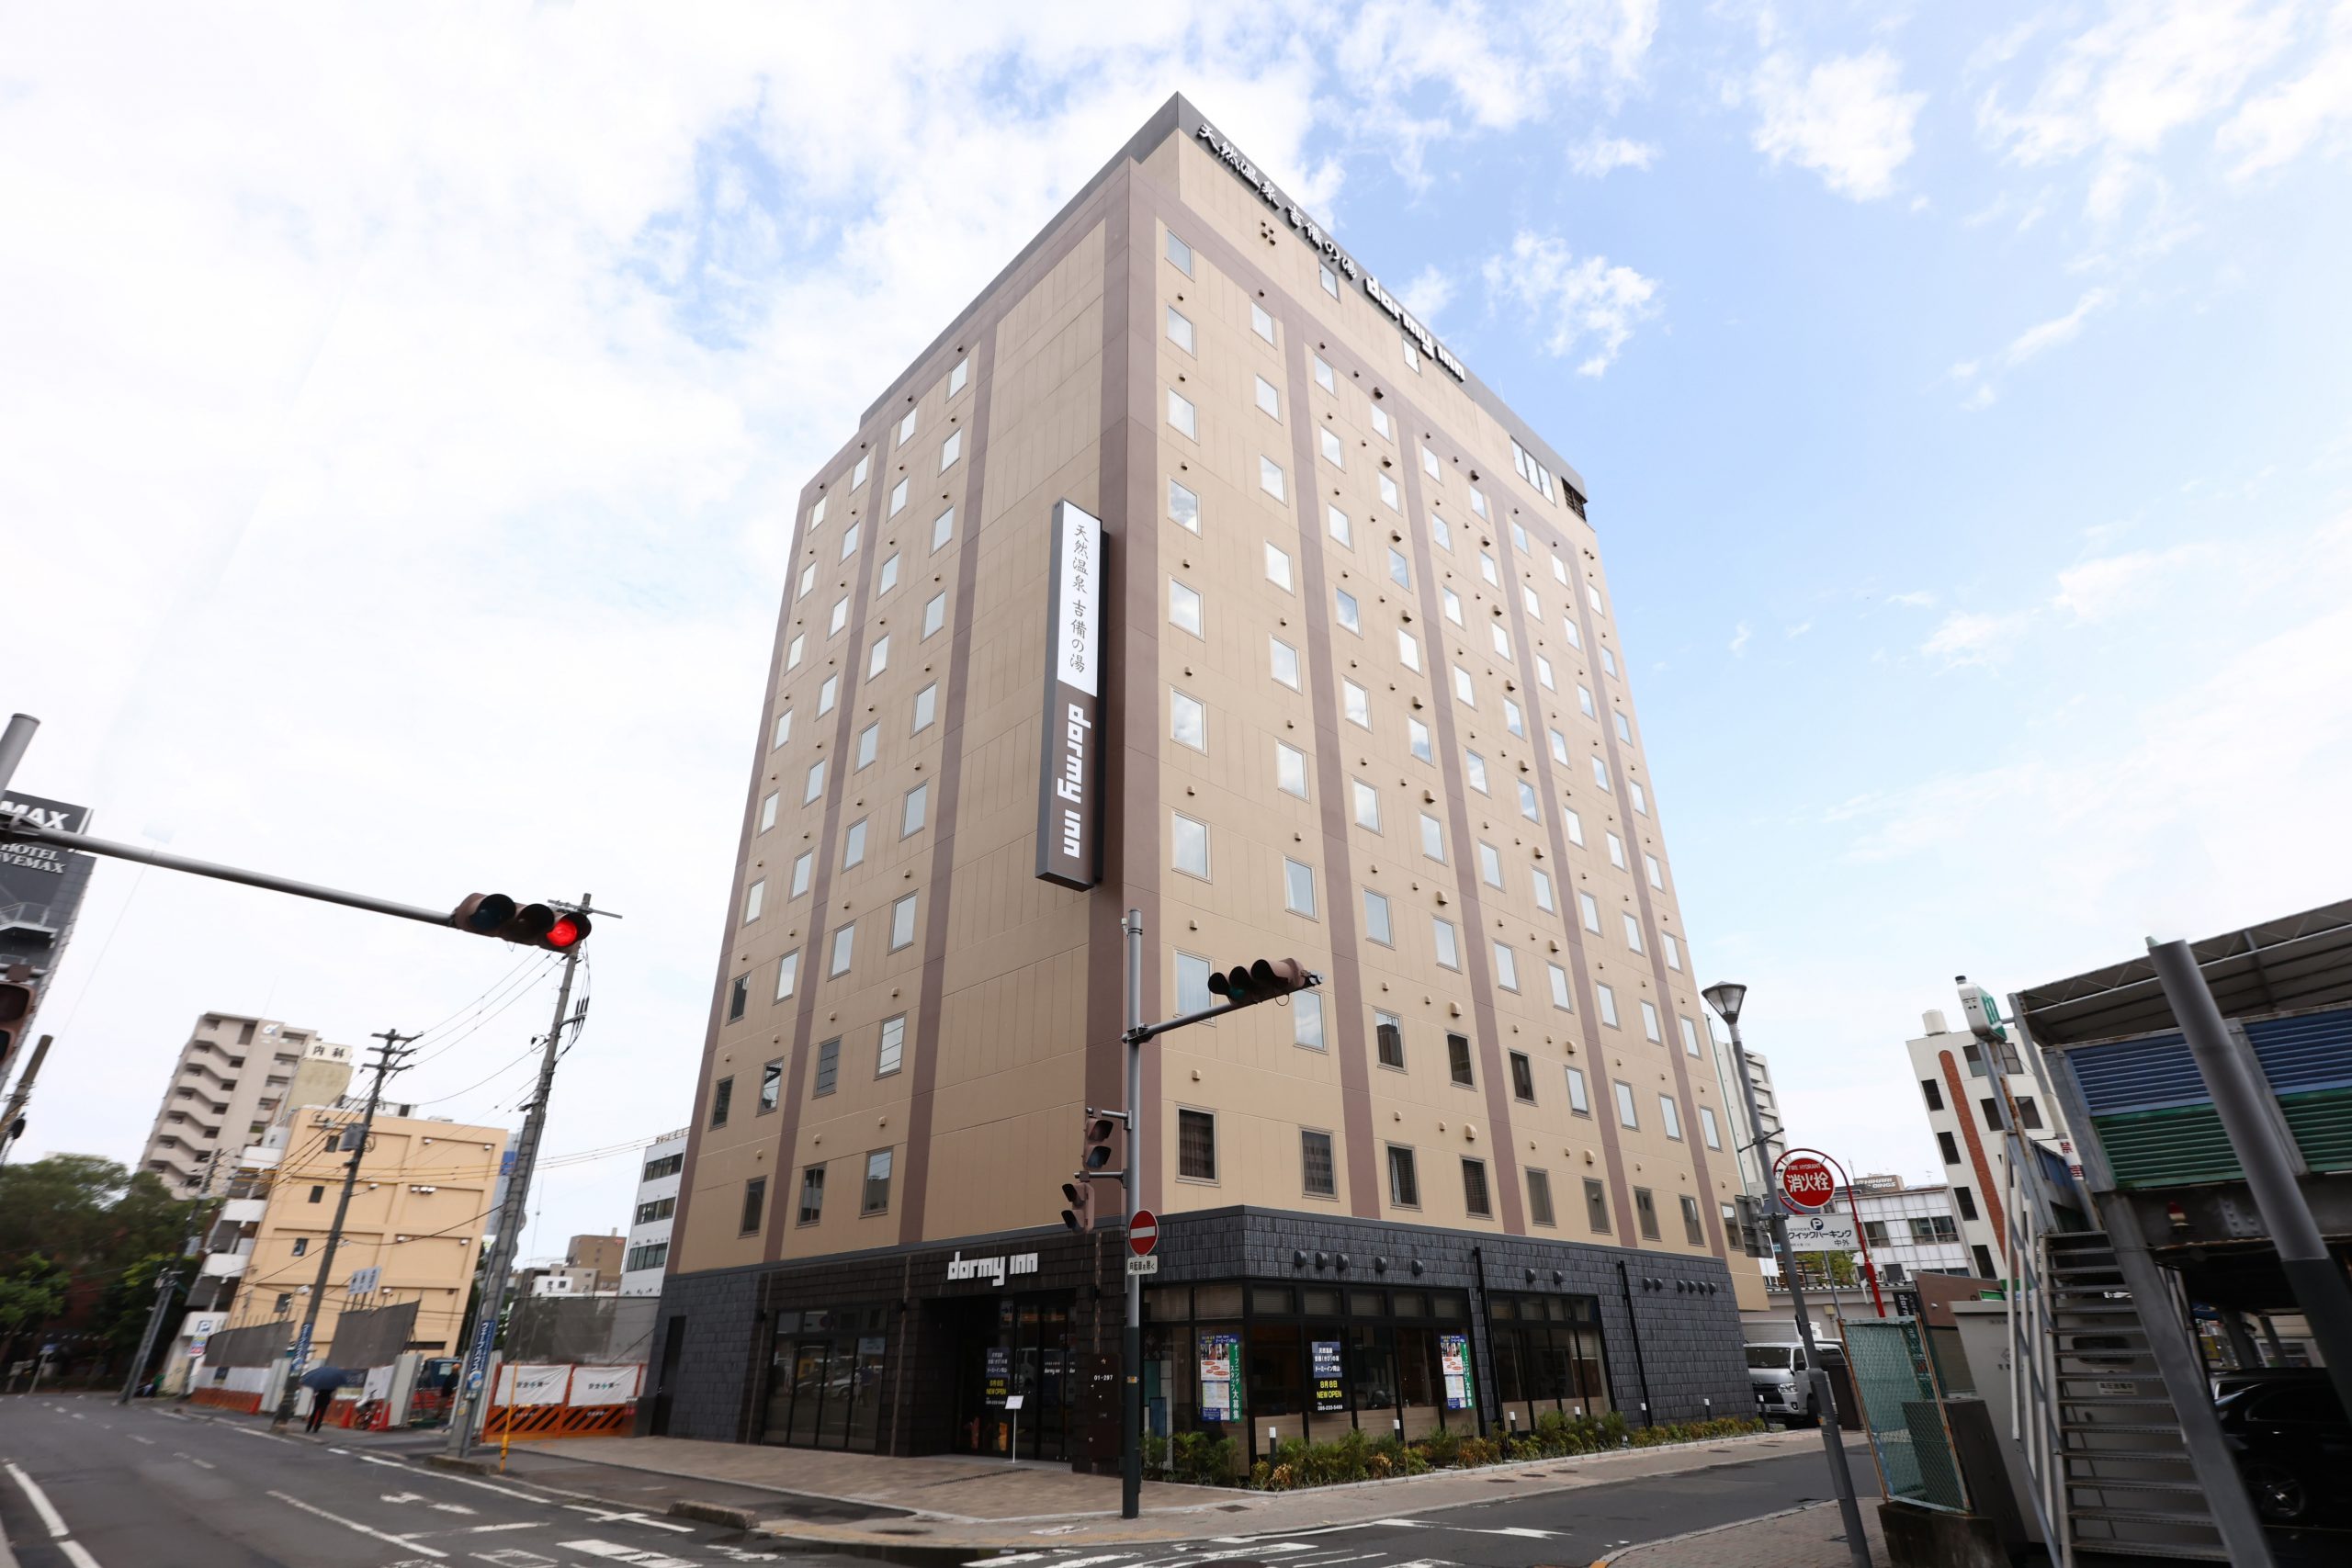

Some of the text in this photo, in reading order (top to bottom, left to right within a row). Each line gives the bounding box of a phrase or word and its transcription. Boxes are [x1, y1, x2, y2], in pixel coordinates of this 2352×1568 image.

[1197, 123, 1357, 280] 天然温泉 吉備の湯
[1364, 276, 1465, 382] dormy inn
[1070, 525, 1089, 673] 天然温泉 吉備の湯
[1057, 703, 1091, 859] dormy inn
[1786, 1171, 1831, 1193] 消火栓
[947, 1251, 1038, 1287] dormy inn
[1317, 1390, 1342, 1399] NEW OPEN
